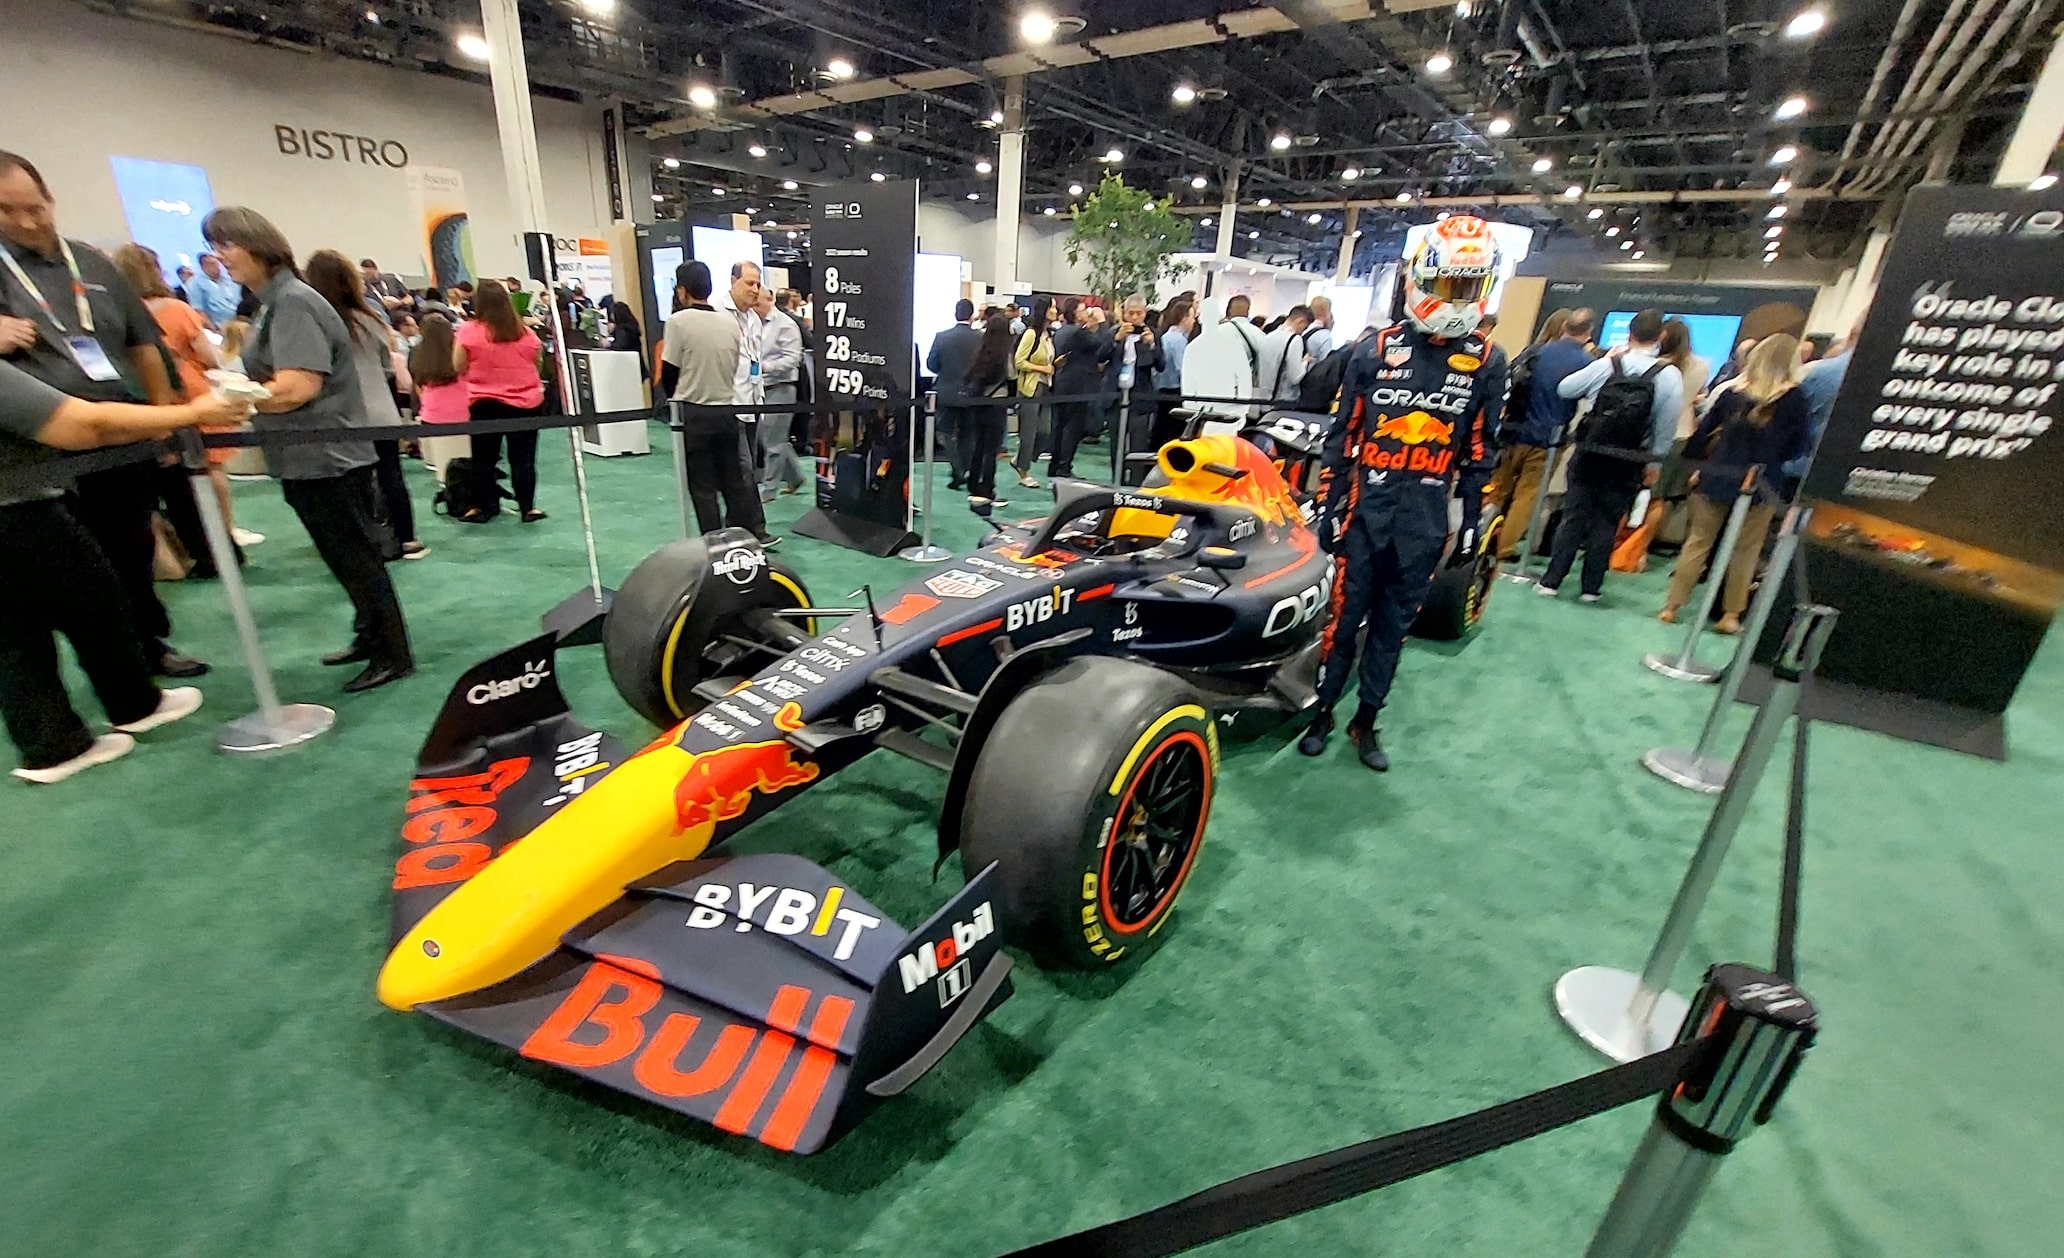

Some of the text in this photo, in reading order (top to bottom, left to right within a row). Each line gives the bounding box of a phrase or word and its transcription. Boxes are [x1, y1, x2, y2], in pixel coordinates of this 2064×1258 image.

[274, 124, 408, 168] BISTRO
[825, 266, 862, 294] 8 Poles
[1437, 266, 1493, 277] ORACLE
[824, 302, 866, 330] 17 Wins
[1912, 294, 2064, 324] Oracle Clo
[825, 335, 887, 366] 28 Podiums
[1901, 320, 2064, 355] has played
[1891, 347, 1950, 378] key
[1948, 352, 2014, 378] role
[2012, 353, 2051, 380] in
[826, 368, 888, 399] 759 Points
[1881, 377, 2058, 408] outcome of
[1372, 388, 1471, 415] ORACLE
[1871, 404, 2053, 438] every single
[1860, 428, 1951, 454] grand
[1362, 441, 1454, 475] Red Bull
[1124, 495, 1153, 508] Tezos
[712, 550, 767, 576] Hard Rock
[965, 557, 1039, 580] ORACLE
[931, 577, 985, 597] HEUER
[944, 571, 994, 589] TAG
[1006, 584, 1076, 633] BYBIT
[1112, 626, 1144, 642] Tezos
[466, 668, 543, 705] Claro
[542, 731, 611, 807] BYBIT
[392, 756, 532, 890] Red
[684, 883, 881, 961] BYBIT
[898, 900, 995, 994] Mobil
[519, 952, 856, 1152] Bull
